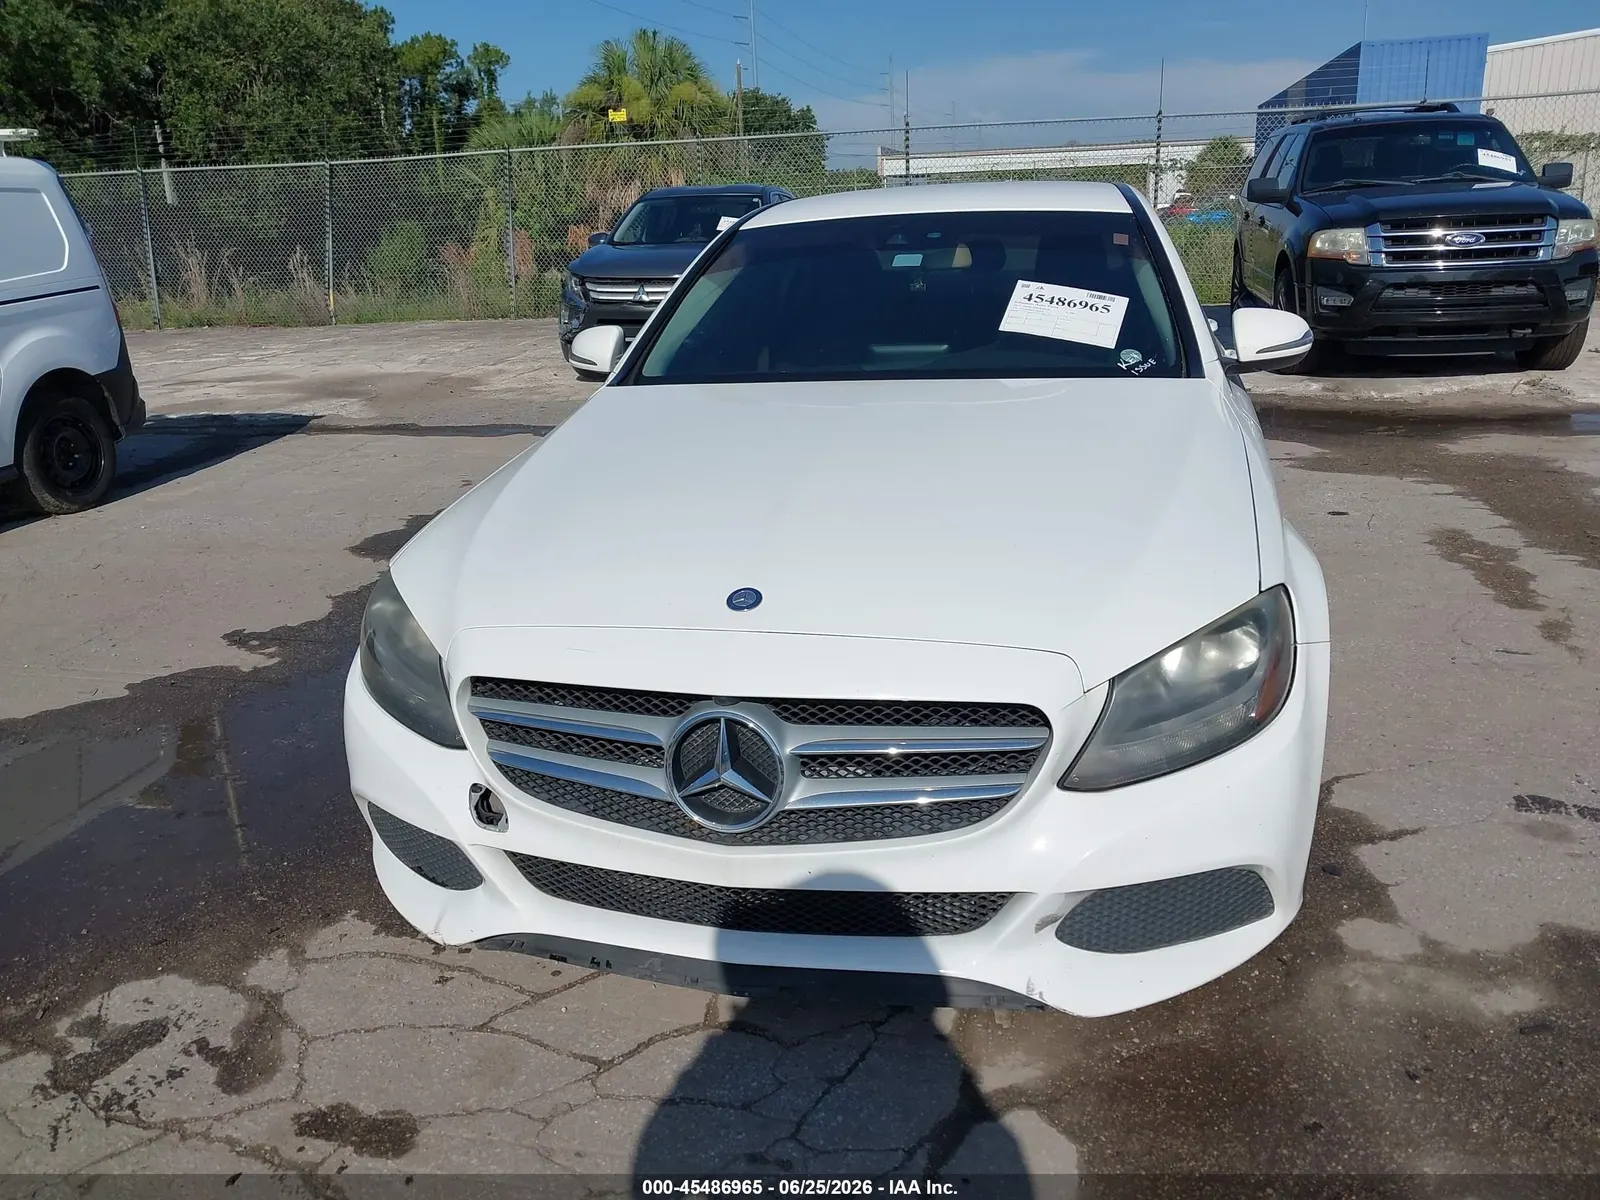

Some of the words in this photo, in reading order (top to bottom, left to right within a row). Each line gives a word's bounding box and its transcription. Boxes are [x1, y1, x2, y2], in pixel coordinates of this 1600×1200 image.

[1453, 234, 1477, 244] Ford
[1022, 292, 1112, 315] 45486965
[1131, 357, 1157, 376] ISSUE
